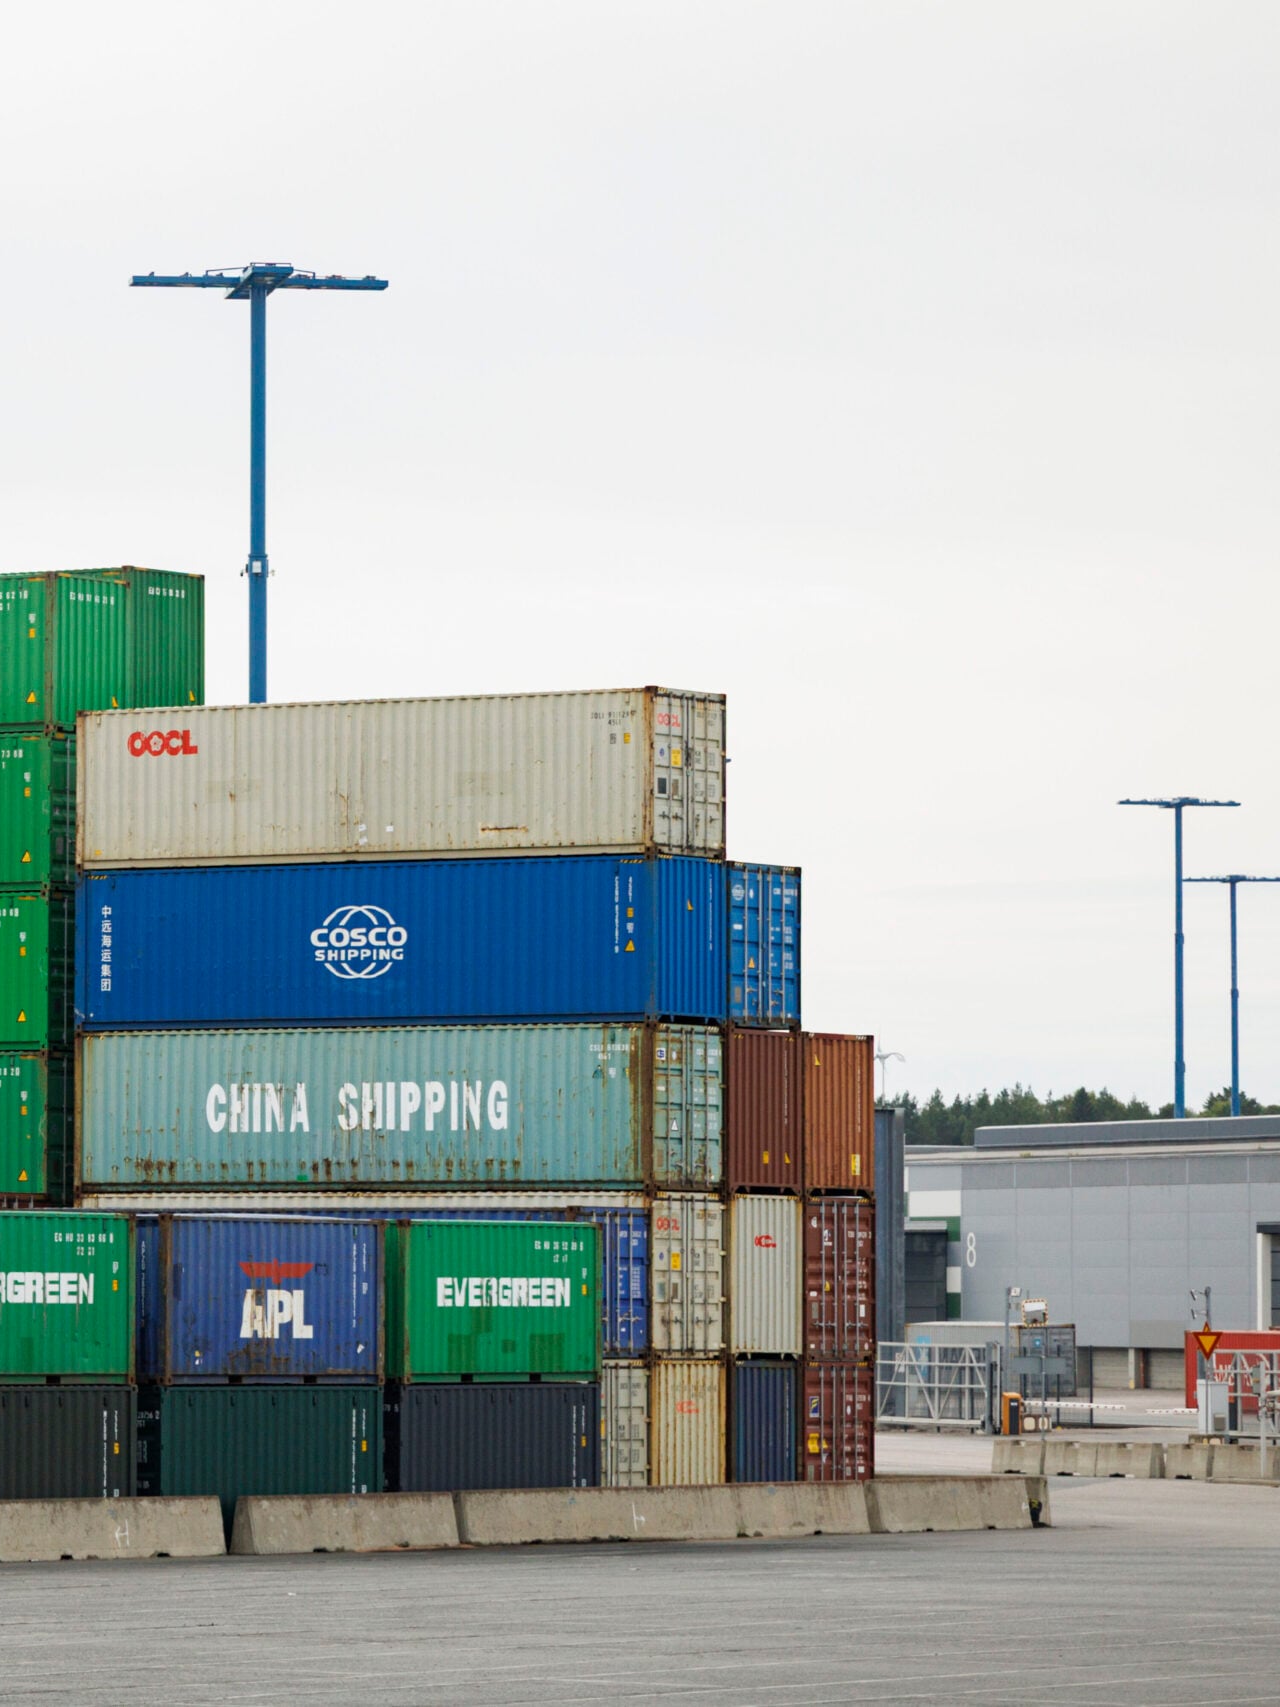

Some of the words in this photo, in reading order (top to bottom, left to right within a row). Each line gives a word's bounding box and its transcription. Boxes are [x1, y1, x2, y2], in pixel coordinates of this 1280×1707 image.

[128, 729, 198, 757] OOCL
[310, 927, 407, 947] COSCO
[315, 948, 404, 961] SHIPPING
[206, 1083, 310, 1133] CHINA
[337, 1080, 508, 1131] SHIPPING
[967, 1232, 976, 1268] 8
[437, 1277, 570, 1307] EVERGREEN
[240, 1289, 313, 1339] APL
